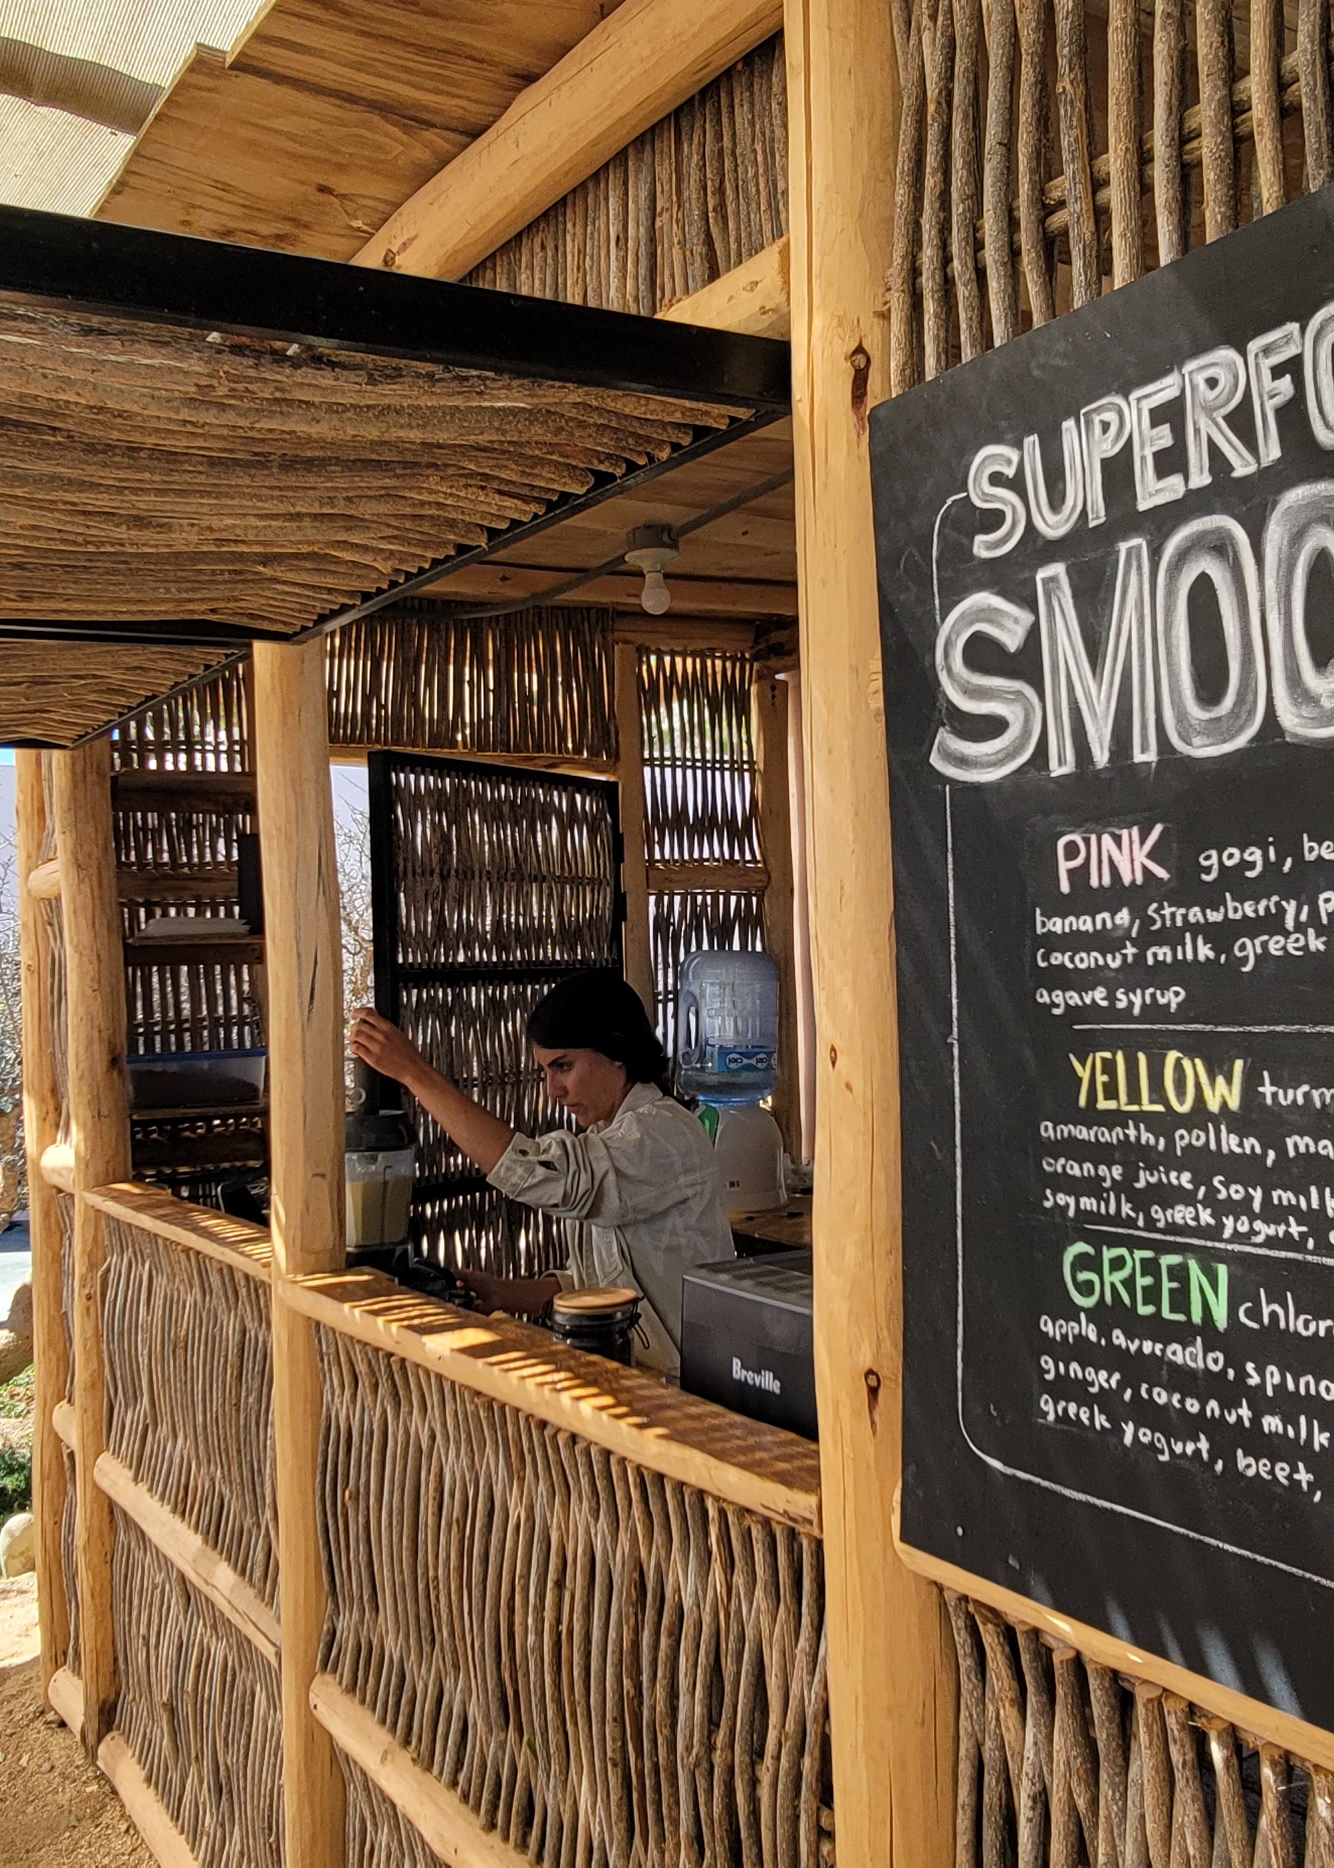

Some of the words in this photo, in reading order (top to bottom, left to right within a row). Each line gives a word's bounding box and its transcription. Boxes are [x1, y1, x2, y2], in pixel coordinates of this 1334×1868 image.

[1056, 823, 1170, 893] PINK
[1199, 838, 1292, 881] gogi,
[1035, 907, 1139, 938] banana,
[1146, 932, 1227, 965] milk,
[1233, 927, 1328, 972] greek
[1035, 986, 1109, 1015] agave
[1116, 985, 1186, 1016] syrup
[1068, 1050, 1245, 1114] YELLOW
[1039, 1119, 1165, 1151] amaranth,
[1174, 1122, 1276, 1168] pollen,
[1042, 1156, 1123, 1188] orange
[1133, 1161, 1205, 1200] juice,
[1150, 1202, 1215, 1229] greek
[1222, 1213, 1314, 1250] yogurt,
[1063, 1240, 1228, 1331] GREEN
[732, 1356, 781, 1395] Breville
[1112, 1328, 1235, 1381] avocado,
[1040, 1354, 1131, 1403] ginger,
[1140, 1382, 1252, 1429] coconut
[1039, 1394, 1111, 1431] greek
[1120, 1420, 1223, 1475] yogurt,
[1236, 1447, 1321, 1502] beet,
